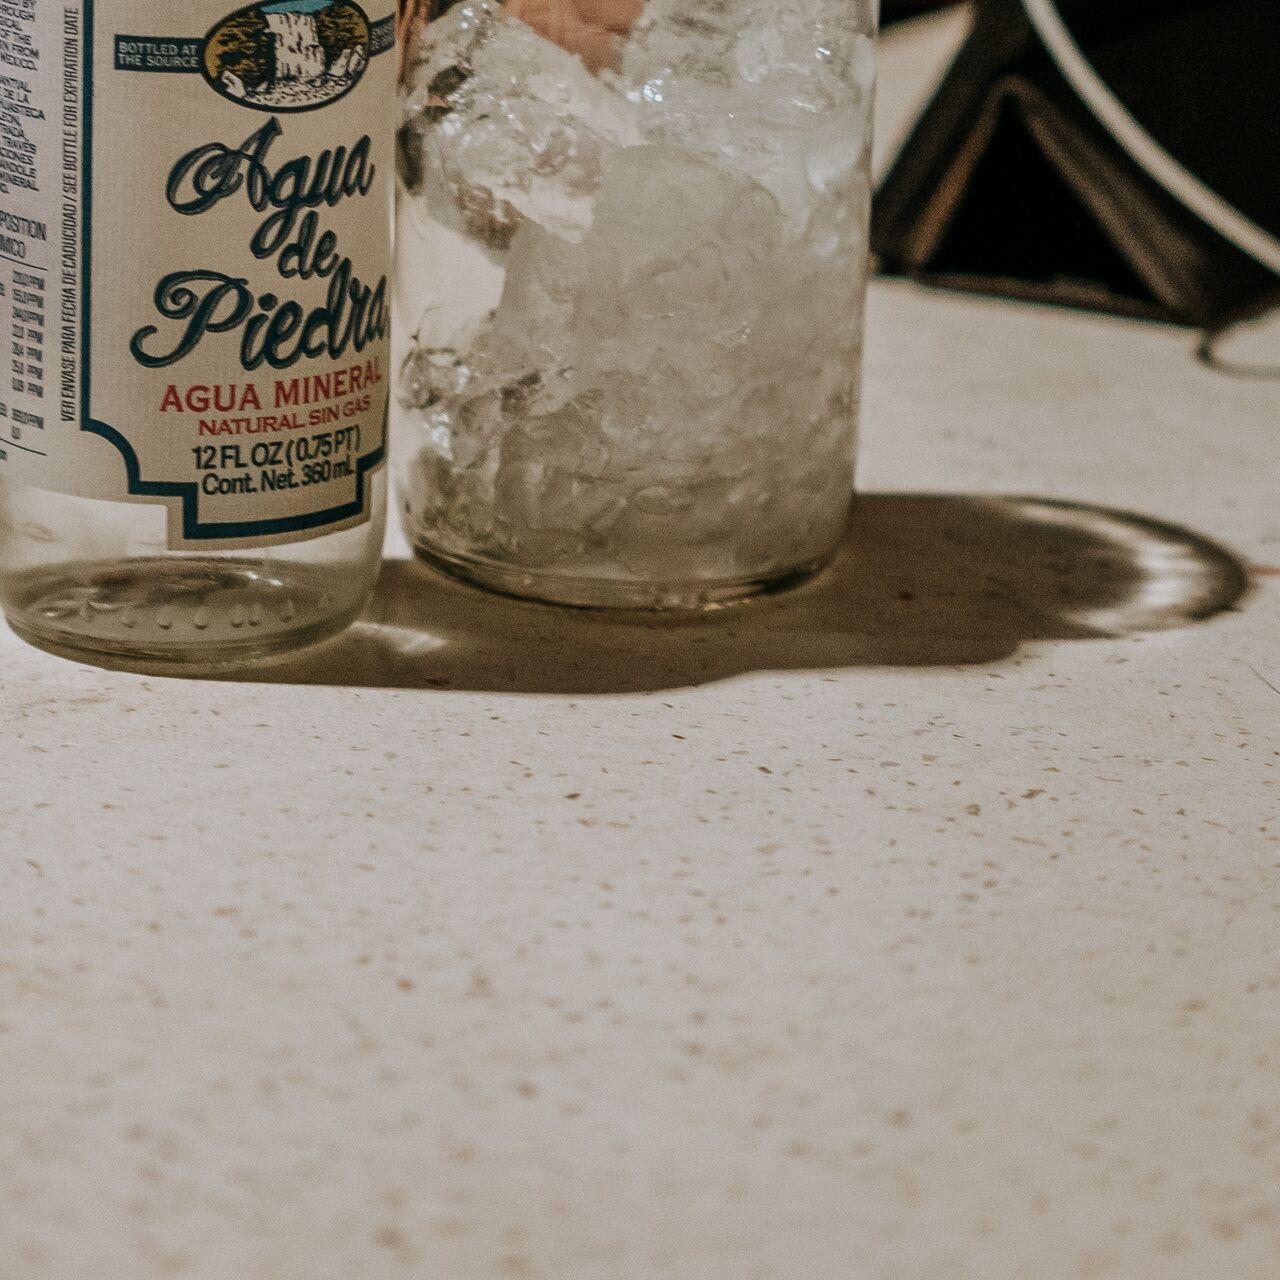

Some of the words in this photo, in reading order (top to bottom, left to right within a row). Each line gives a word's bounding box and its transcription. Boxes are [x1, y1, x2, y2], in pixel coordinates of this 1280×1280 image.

[63, 6, 79, 36] DATE
[118, 53, 142, 66] THE
[146, 55, 199, 67] SOURCE
[119, 41, 179, 55] BOTTLED
[181, 44, 198, 55] AT
[63, 38, 79, 104] EXPIRATION
[63, 105, 78, 128] FOR
[62, 128, 78, 171] BOTTLE
[62, 172, 78, 194] SEE
[166, 116, 376, 260] Agua
[62, 203, 77, 268] CADUCIDAD
[277, 210, 340, 280] de
[62, 269, 77, 286] DE
[61, 288, 77, 323] FECHA
[129, 256, 390, 371] Piedra
[61, 325, 76, 354] PARA
[61, 356, 76, 399] ENVASE
[159, 383, 263, 413] AGUA
[274, 360, 382, 408] MINERAL
[61, 401, 76, 422] VER
[198, 412, 305, 436] NATURAL
[308, 404, 340, 426] SIN
[342, 394, 371, 418] GAS
[191, 445, 217, 470] 12
[220, 444, 248, 469] FL
[251, 441, 284, 467] OZ
[202, 472, 257, 496] Cont.
[261, 469, 299, 491] Net.
[302, 459, 331, 486] 360
